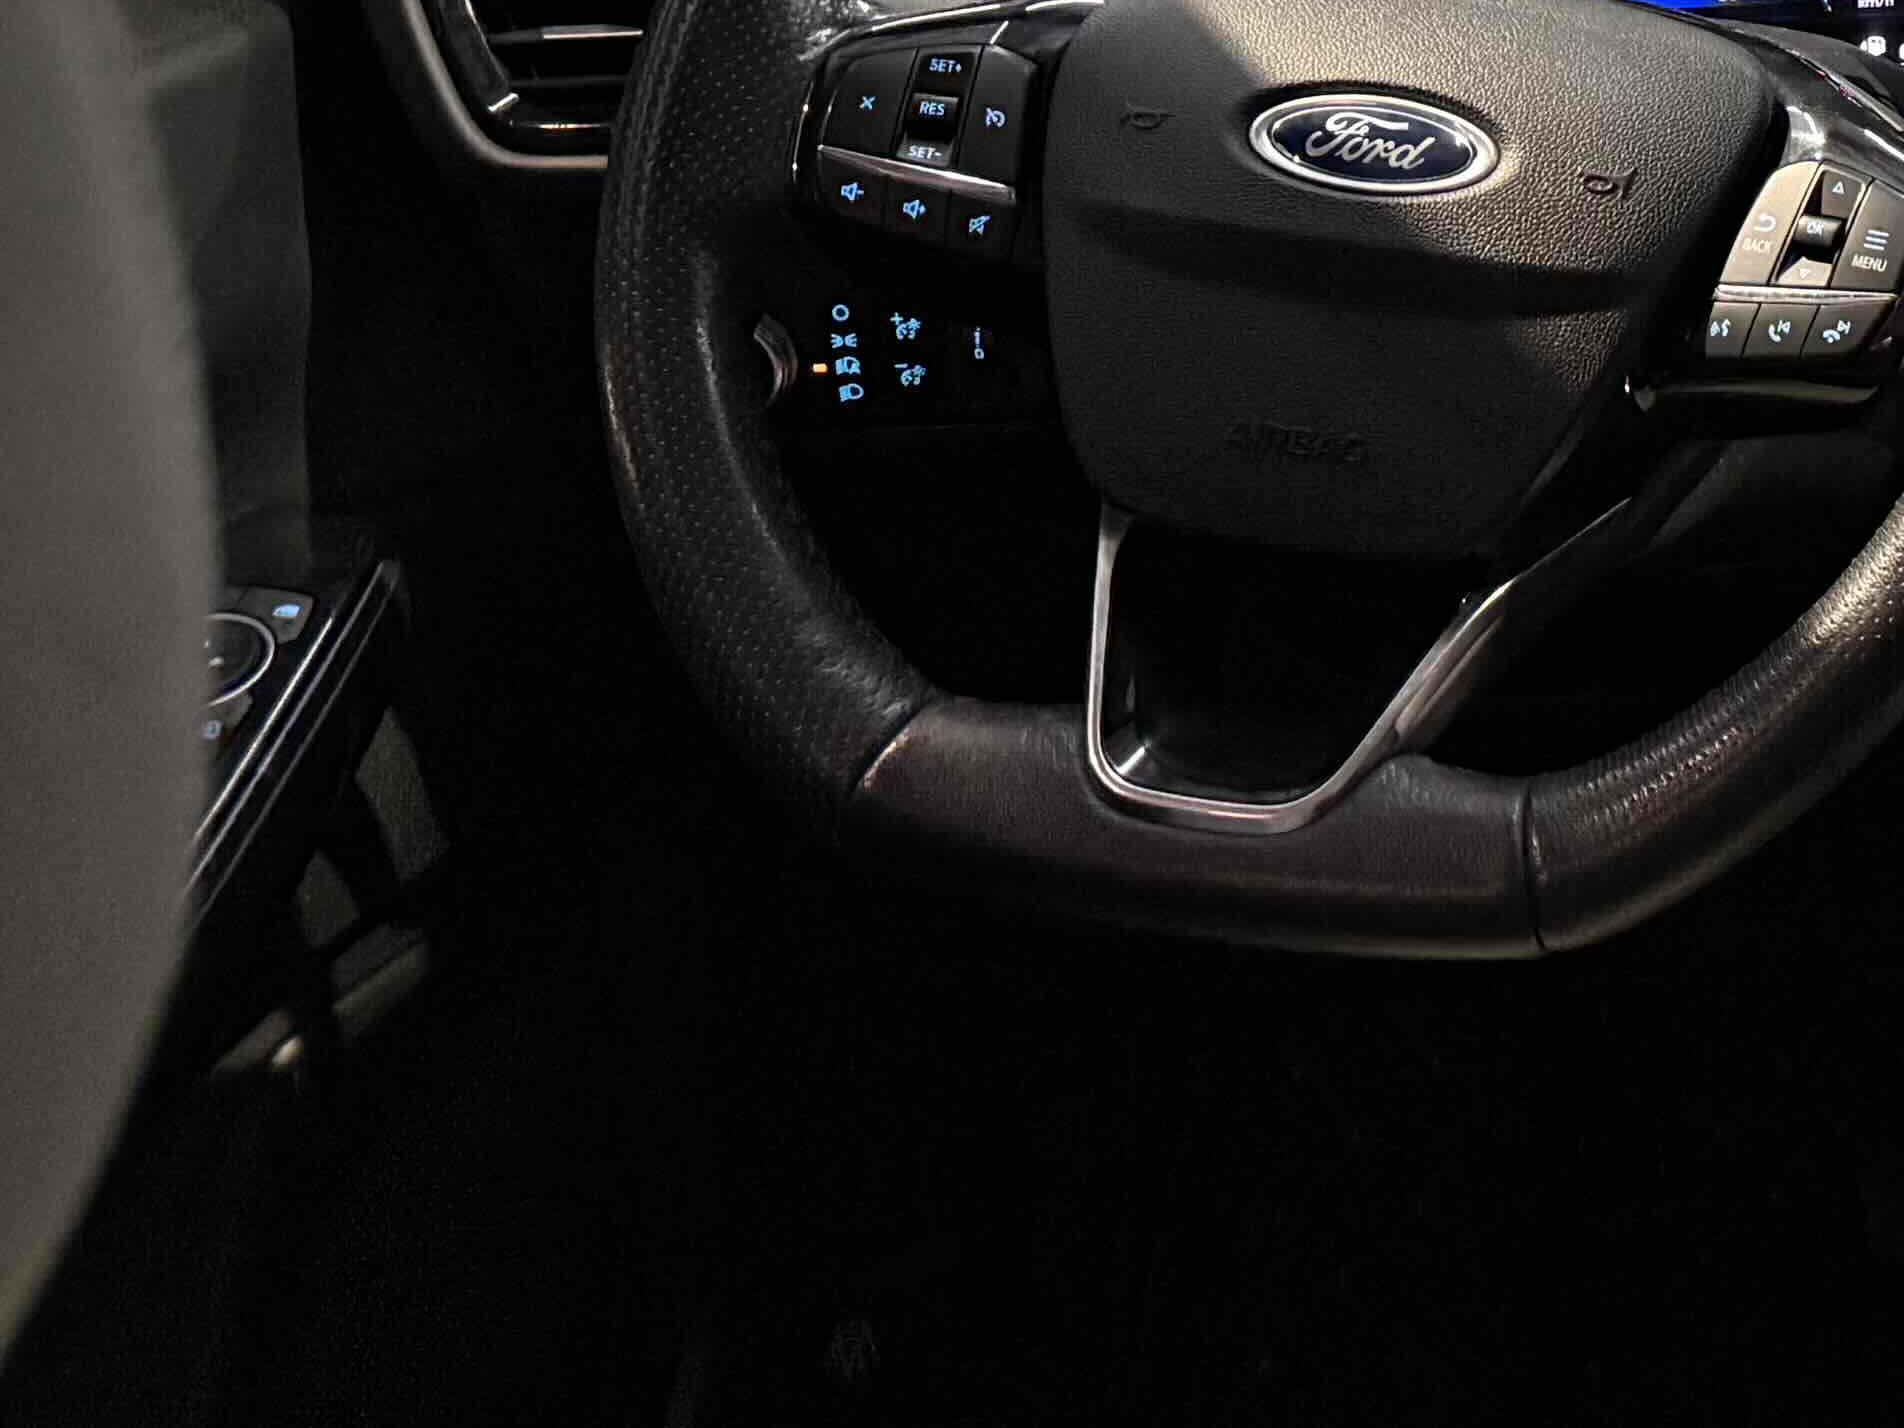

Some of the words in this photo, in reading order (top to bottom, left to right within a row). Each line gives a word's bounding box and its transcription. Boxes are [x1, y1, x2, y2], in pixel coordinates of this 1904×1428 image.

[919, 100, 946, 117] RES
[1304, 111, 1436, 170] Ford
[1743, 238, 1772, 255] BACK
[1851, 254, 1888, 273] MENU
